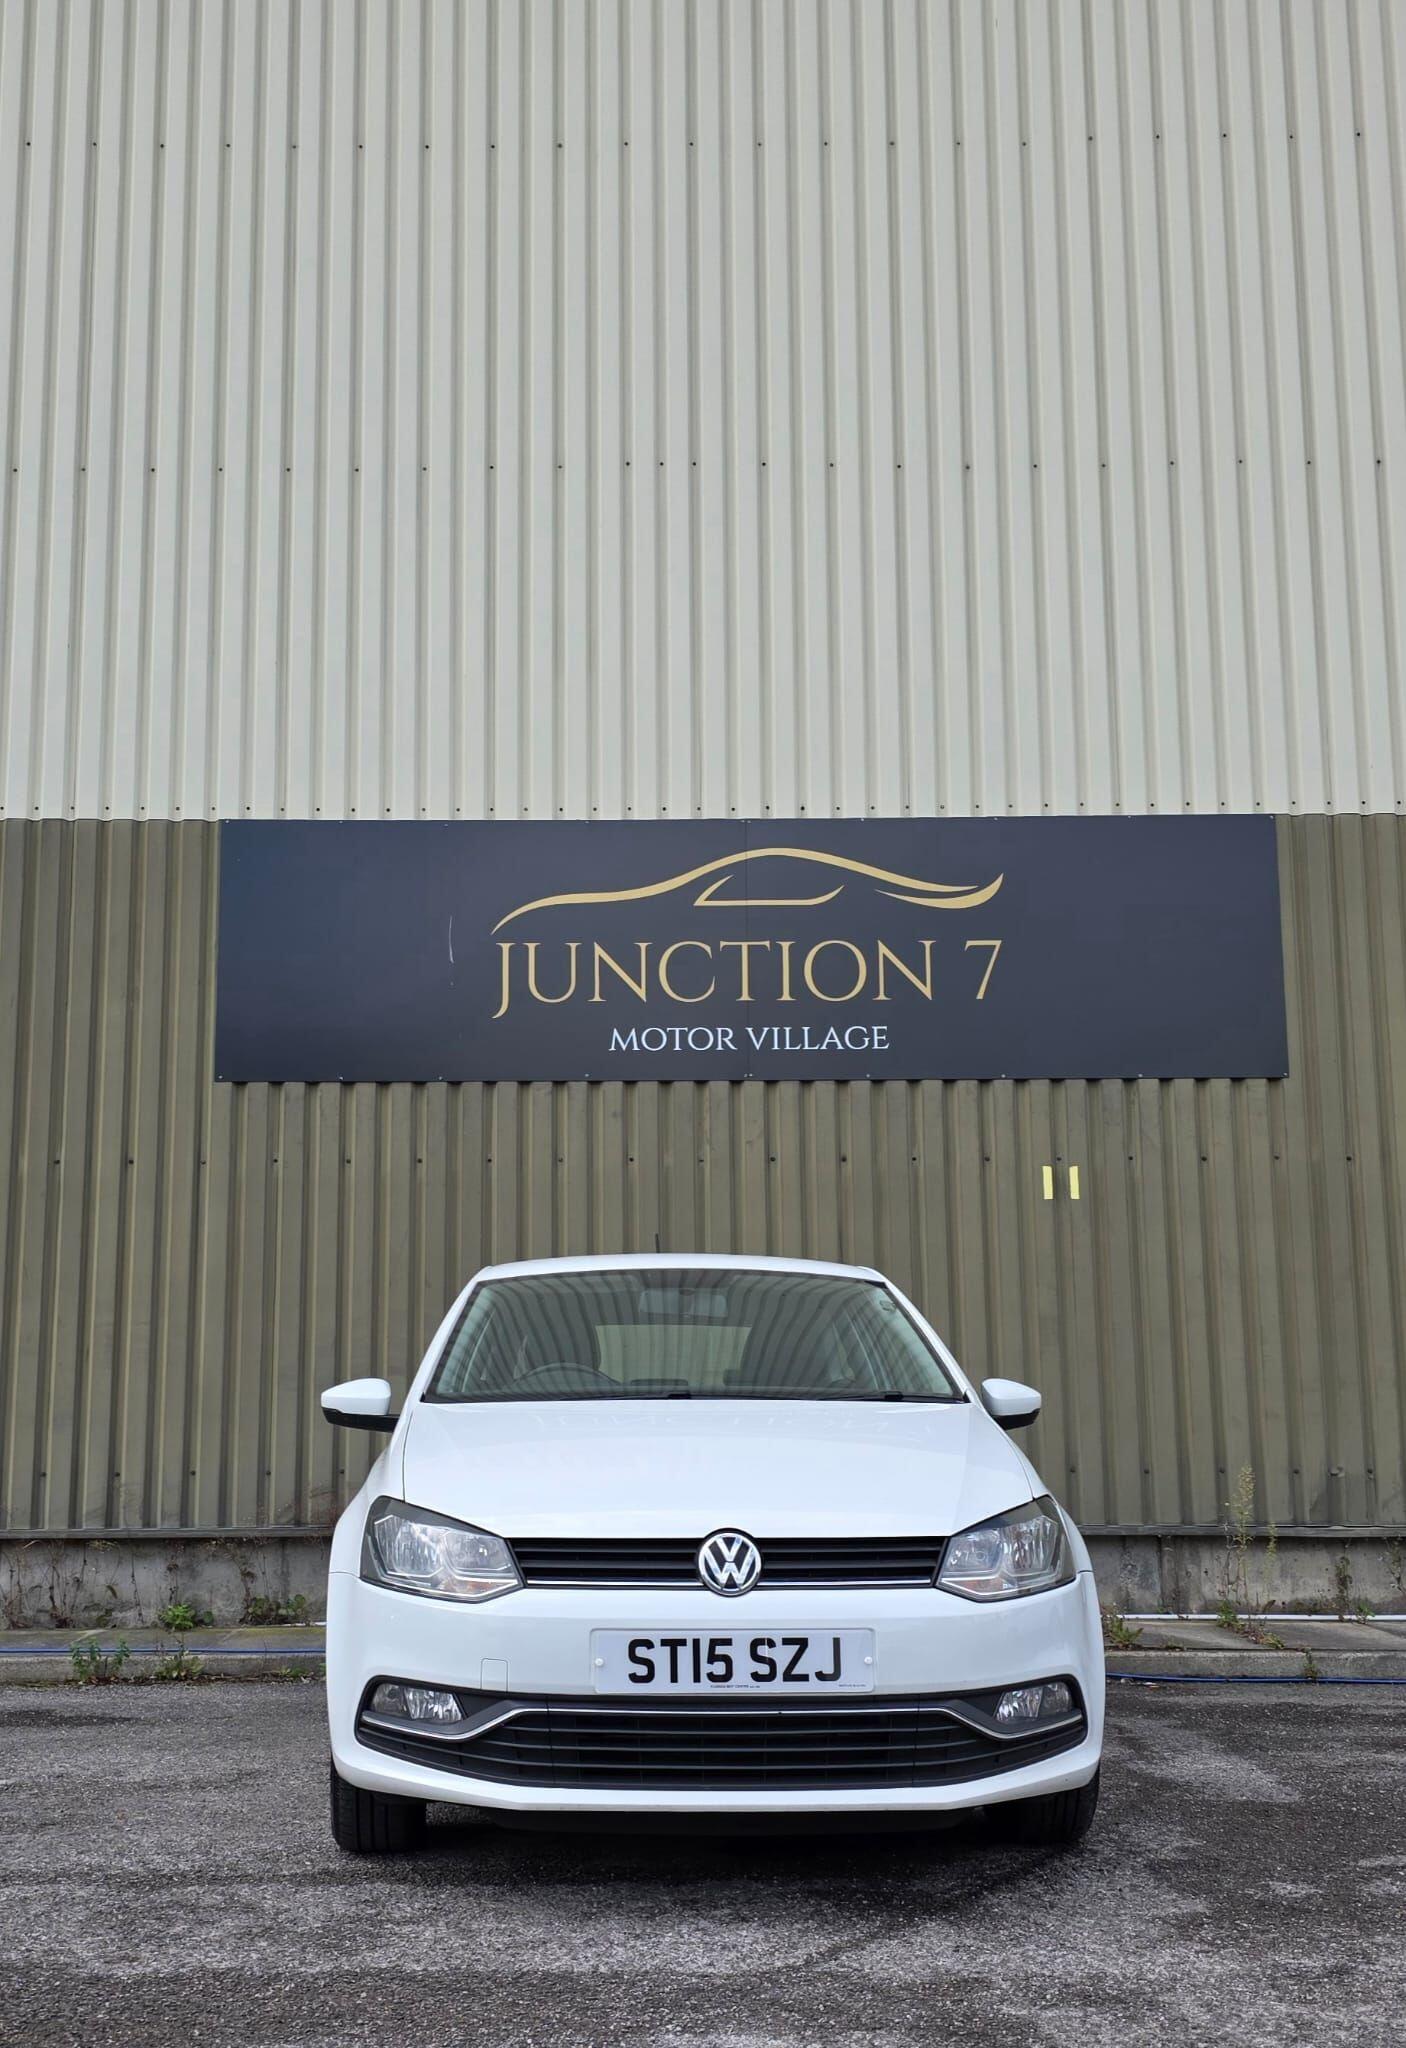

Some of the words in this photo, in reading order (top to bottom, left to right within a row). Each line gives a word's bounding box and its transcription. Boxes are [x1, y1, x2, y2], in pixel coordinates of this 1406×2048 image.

[492, 940, 934, 1019] JUNCTION
[965, 940, 1003, 1000] 7
[608, 1026, 737, 1052] MOTOR
[746, 1025, 891, 1051] VILLAGE
[699, 1532, 761, 1594] VW
[628, 1637, 734, 1684] ST15
[750, 1637, 842, 1683] SZJ
